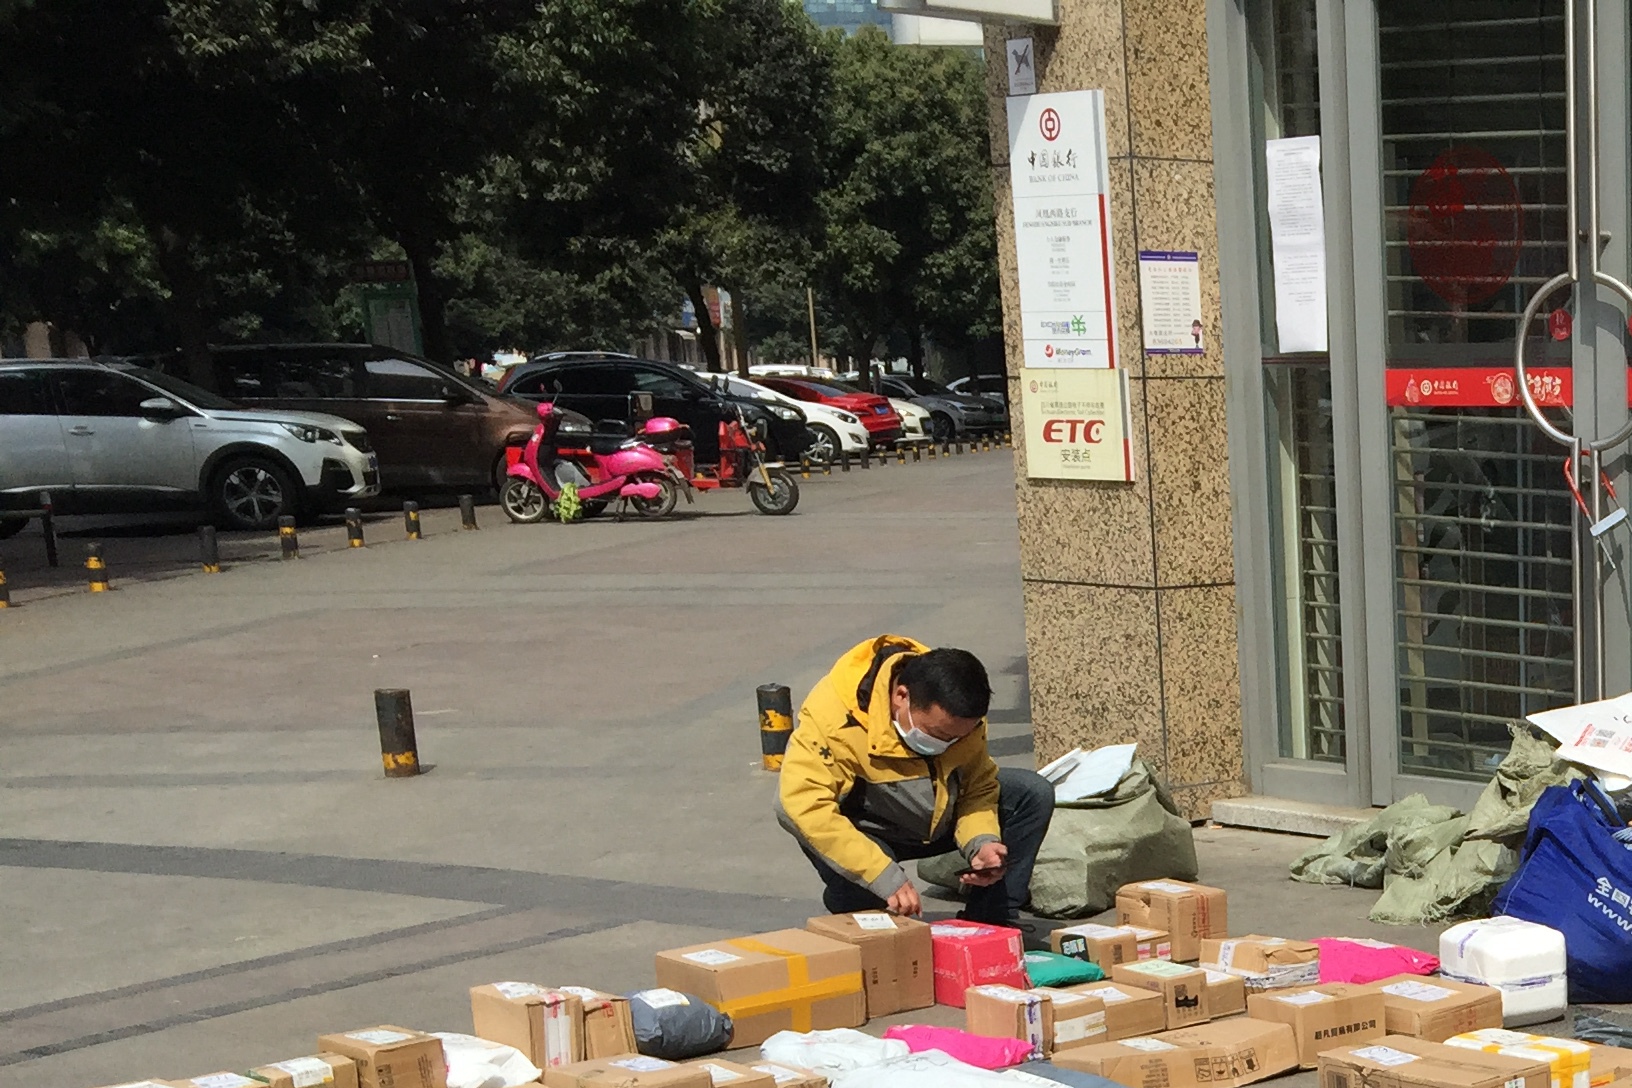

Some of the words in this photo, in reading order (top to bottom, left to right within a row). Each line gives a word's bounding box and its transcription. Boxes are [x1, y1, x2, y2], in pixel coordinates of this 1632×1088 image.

[1027, 148, 1078, 170] 中国银行
[1029, 175, 1047, 183] BANK
[1058, 173, 1079, 182] CHINA
[1056, 348, 1091, 357] MoneyGram
[1043, 419, 1105, 443] ETC
[1061, 449, 1091, 462] 安装点
